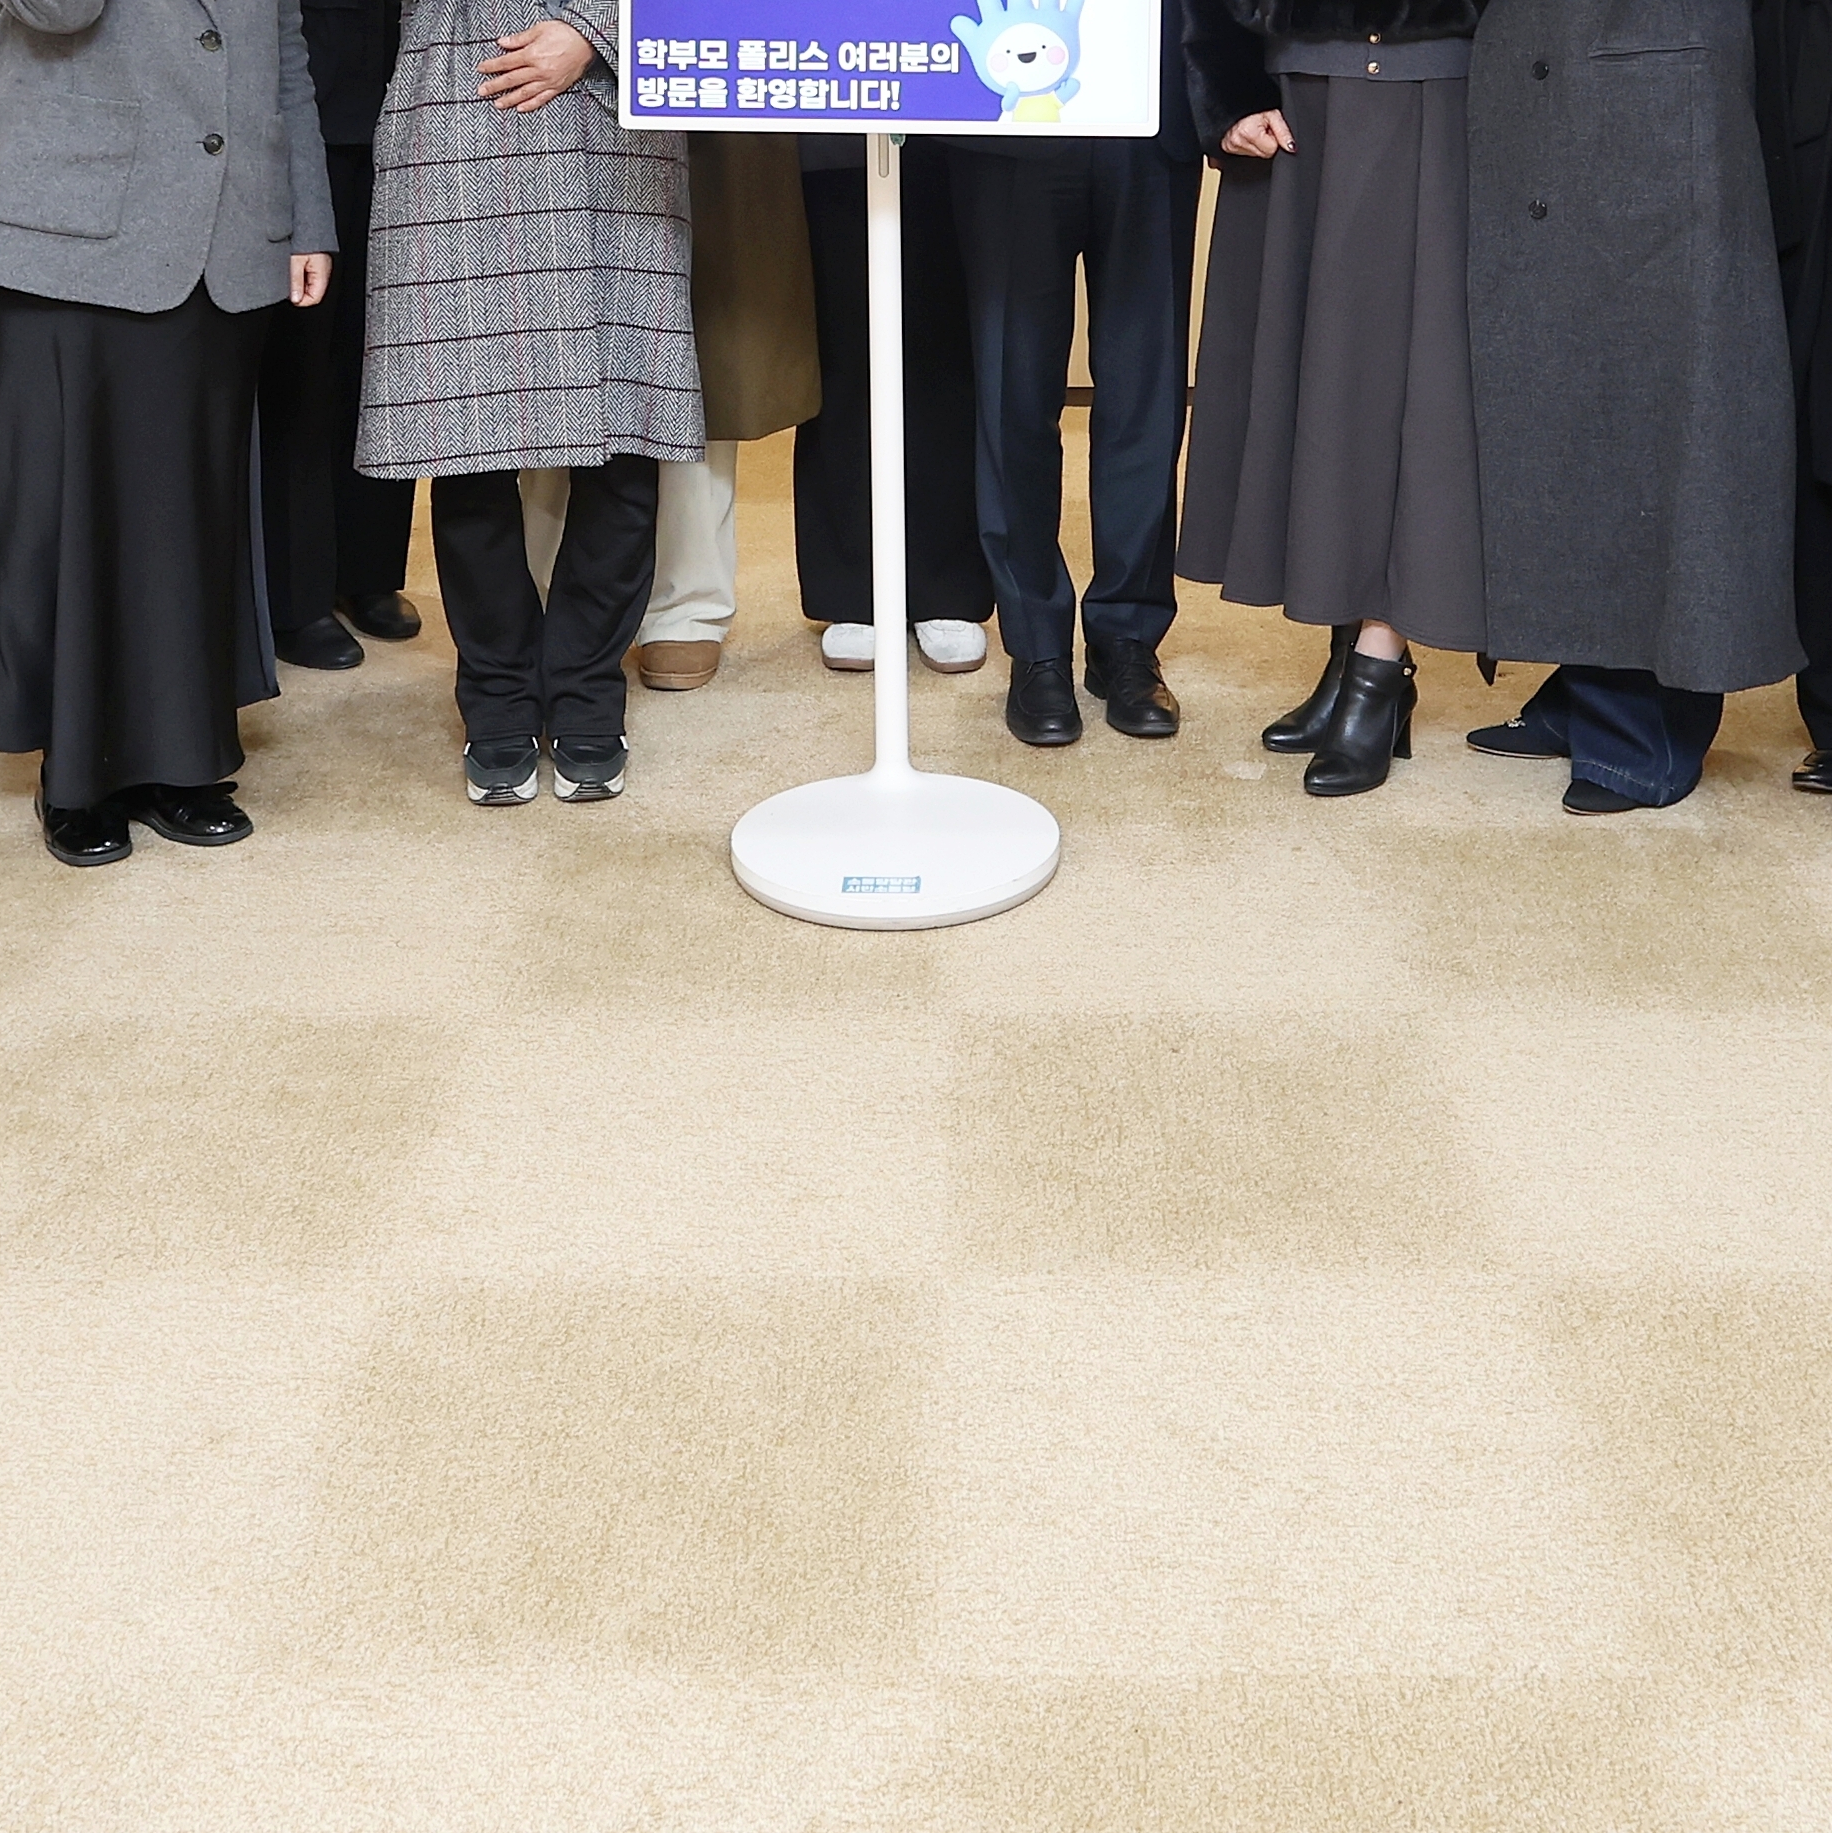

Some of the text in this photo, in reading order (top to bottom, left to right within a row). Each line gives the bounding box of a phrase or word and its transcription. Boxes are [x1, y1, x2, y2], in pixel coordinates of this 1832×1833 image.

[636, 39, 960, 73] 학부모 폴리스 여러분의
[636, 76, 901, 111] 방문을 환영합니다!
